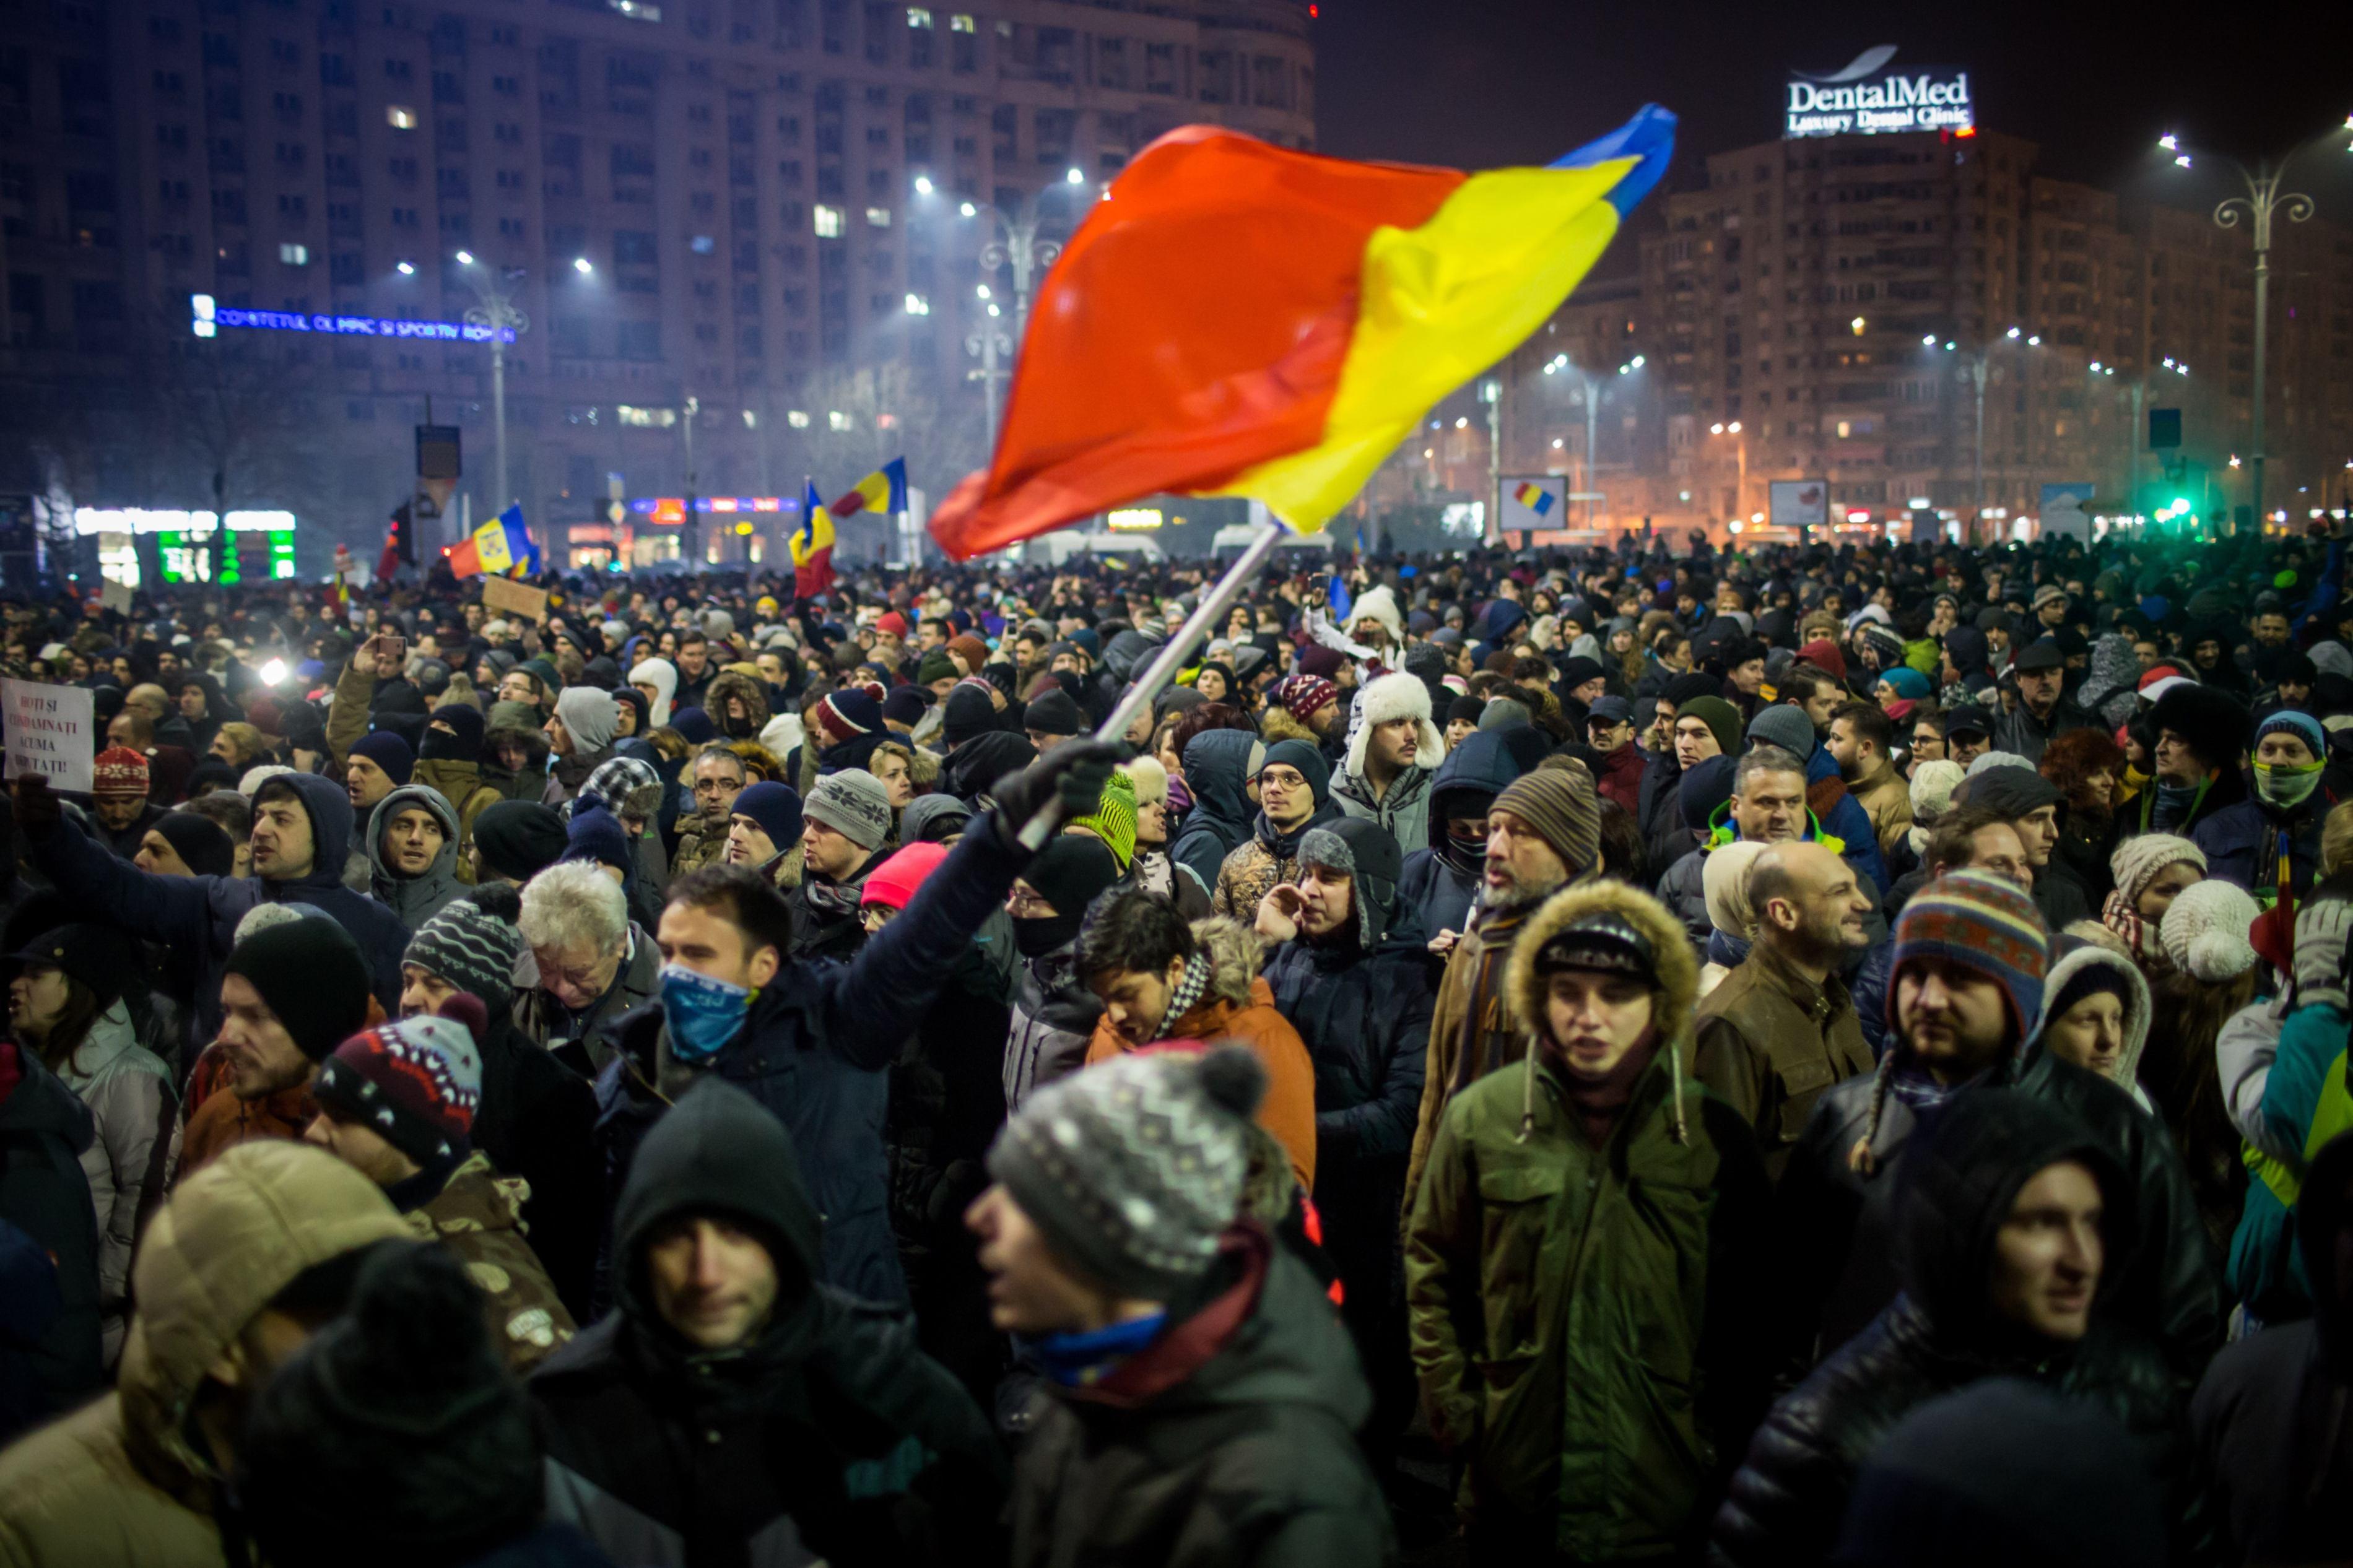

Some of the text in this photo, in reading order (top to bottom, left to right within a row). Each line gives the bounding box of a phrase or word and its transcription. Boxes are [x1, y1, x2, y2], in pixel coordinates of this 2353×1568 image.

[1788, 72, 1969, 112] DentalMed
[1788, 105, 1970, 132] Luxury Dental Clinic
